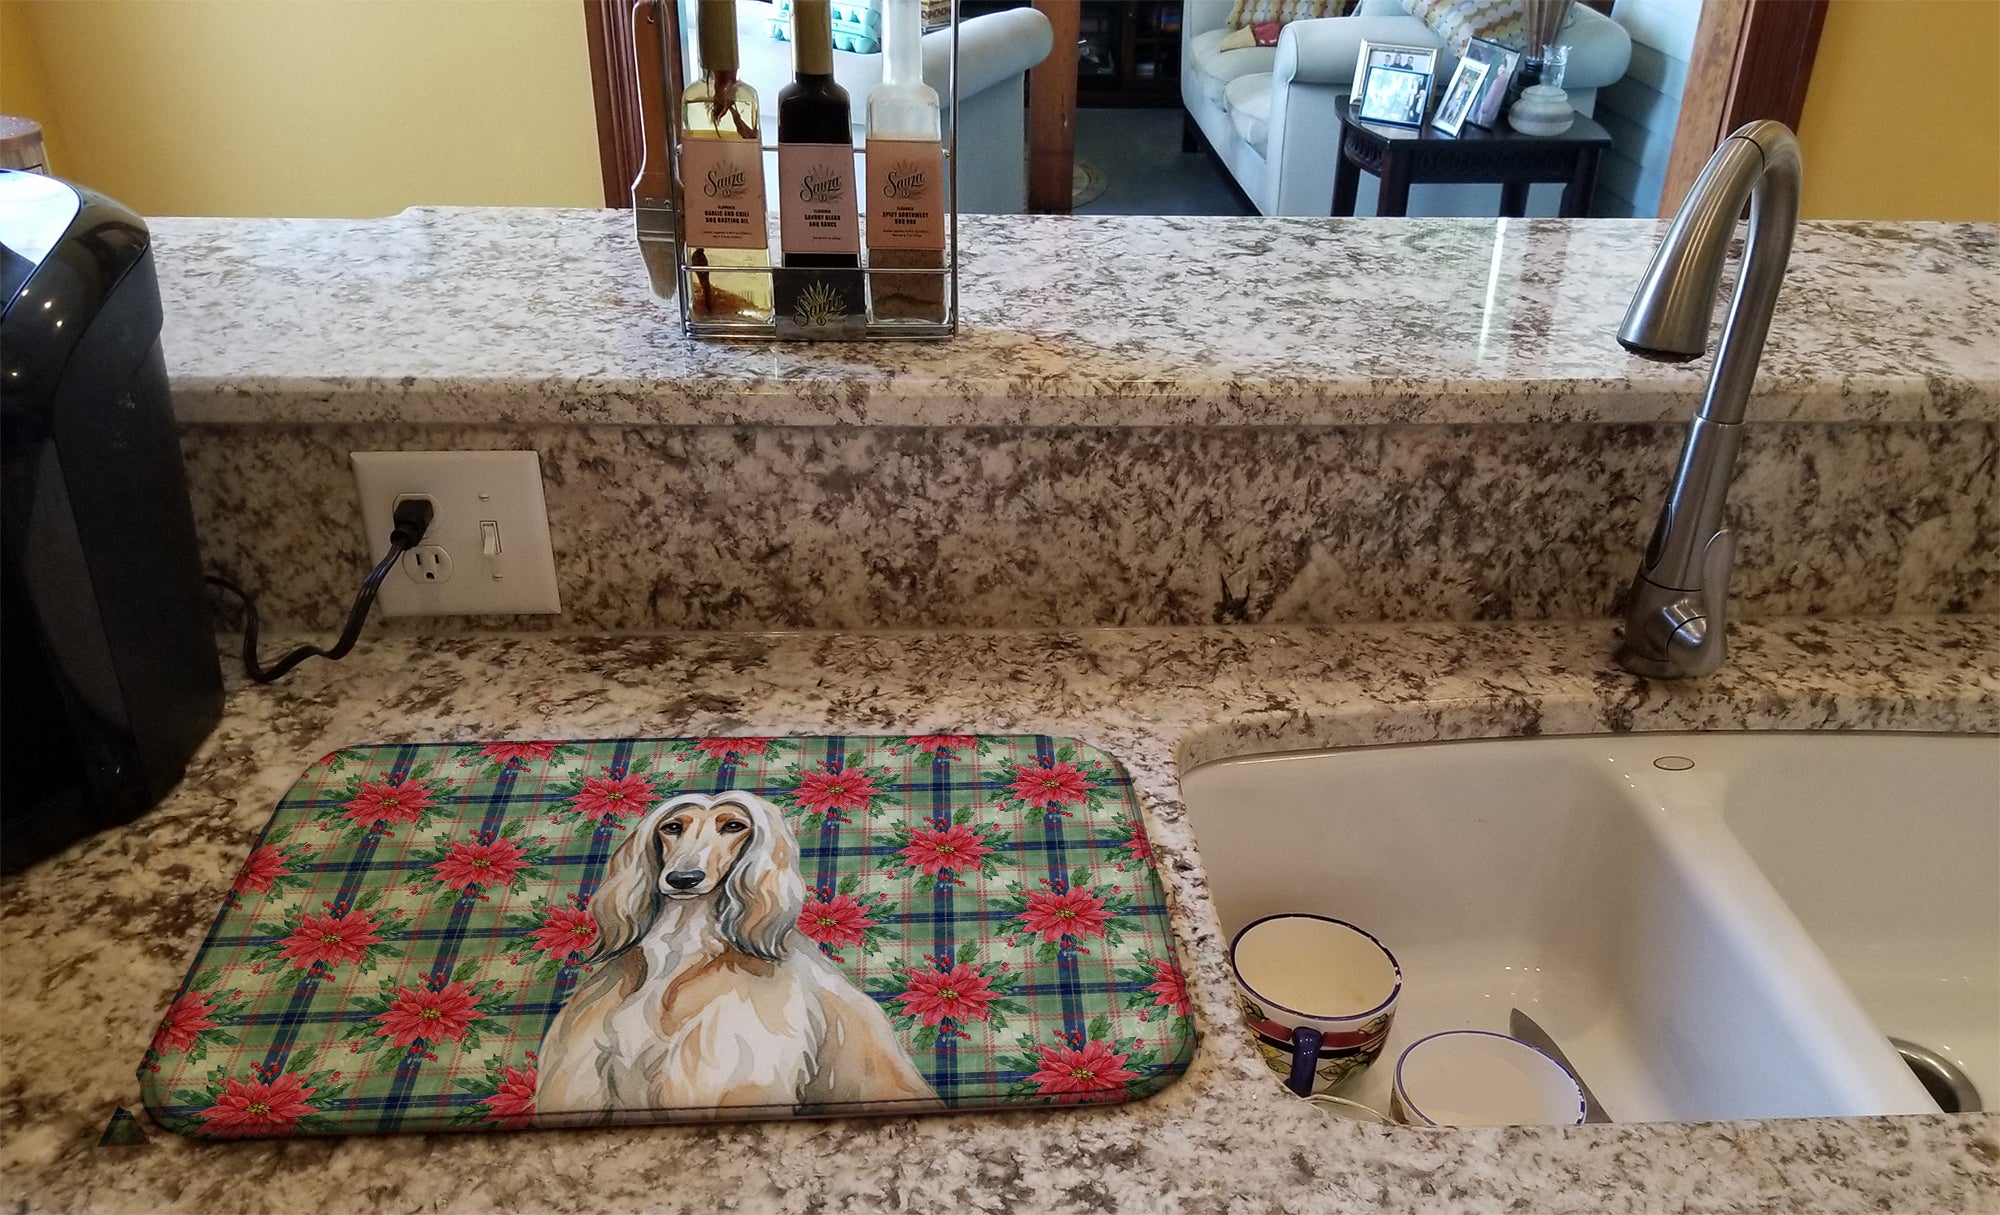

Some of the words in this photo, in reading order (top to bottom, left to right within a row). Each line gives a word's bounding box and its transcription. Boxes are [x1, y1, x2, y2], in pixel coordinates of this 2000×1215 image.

[704, 170, 745, 197] Sauza
[800, 176, 841, 202] Sauza
[884, 171, 926, 198] Sauza
